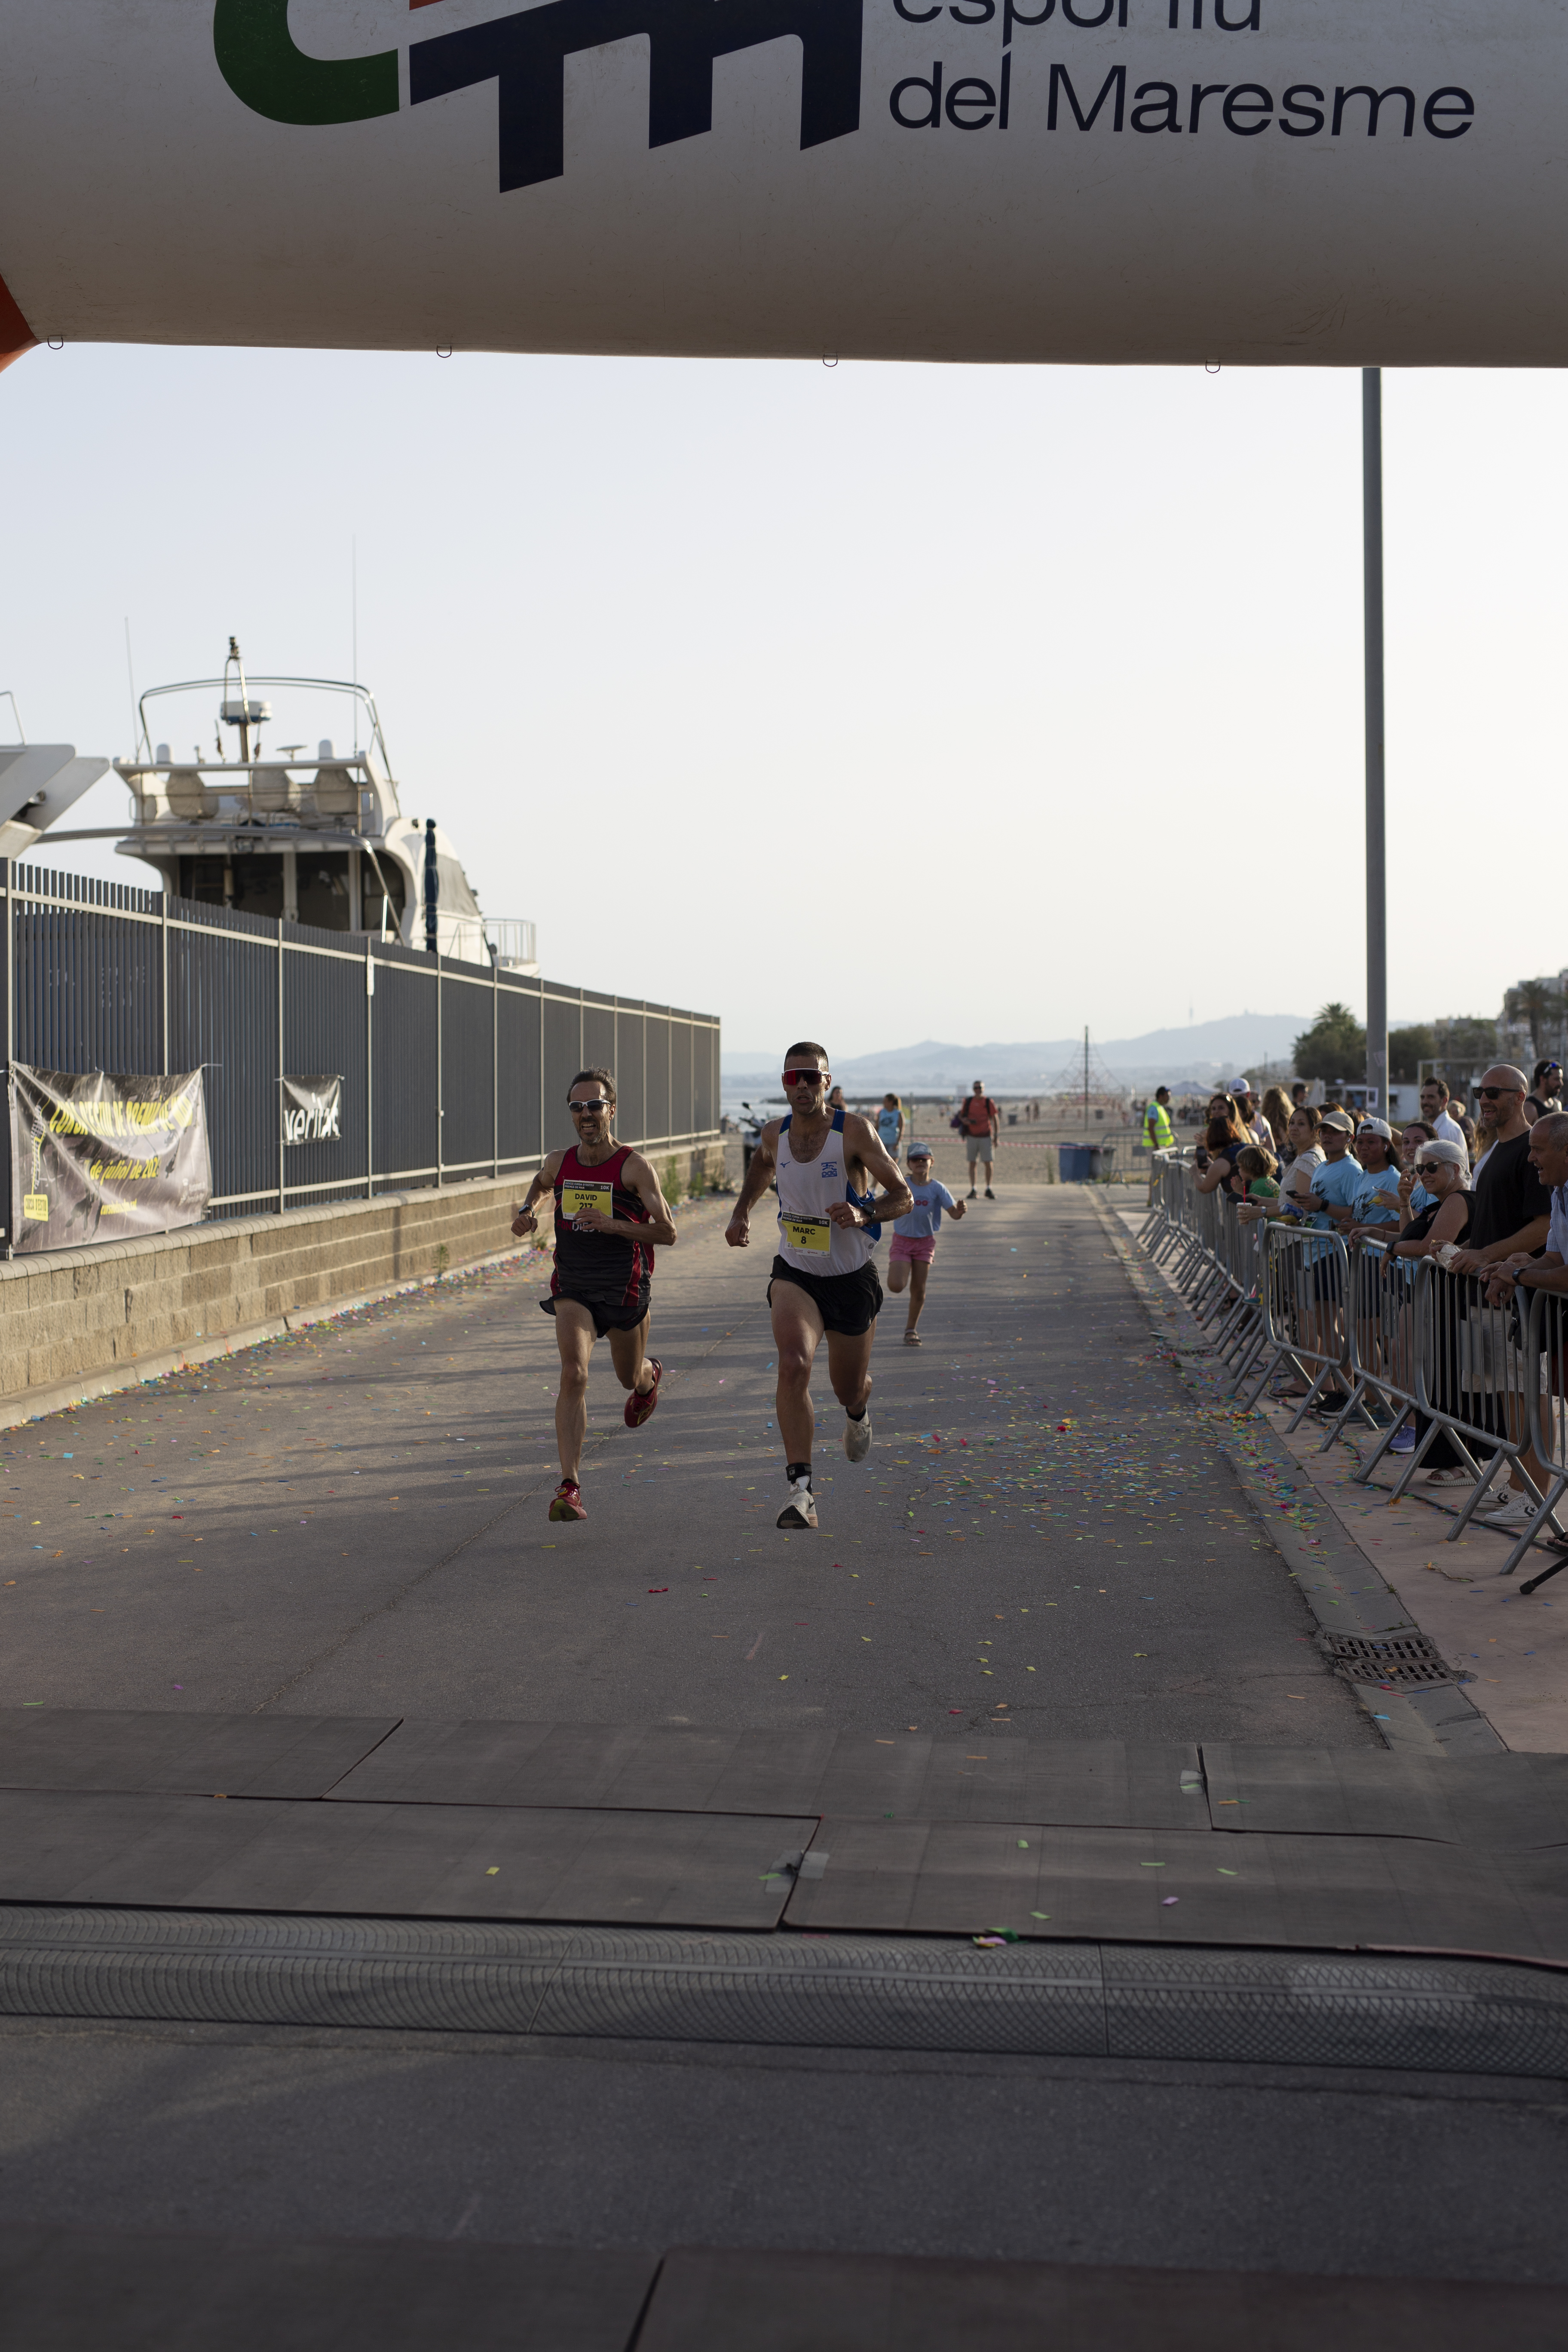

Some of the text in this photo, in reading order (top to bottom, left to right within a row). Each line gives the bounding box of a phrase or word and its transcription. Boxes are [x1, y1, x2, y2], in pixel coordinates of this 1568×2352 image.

[889, 51, 1011, 131] del
[1047, 64, 1475, 139] Maresme
[90, 1159, 103, 1180] de
[100, 1159, 133, 1186] juliol
[129, 1159, 142, 1180] de
[793, 1226, 816, 1235] MARC
[800, 1236, 807, 1244] 8
